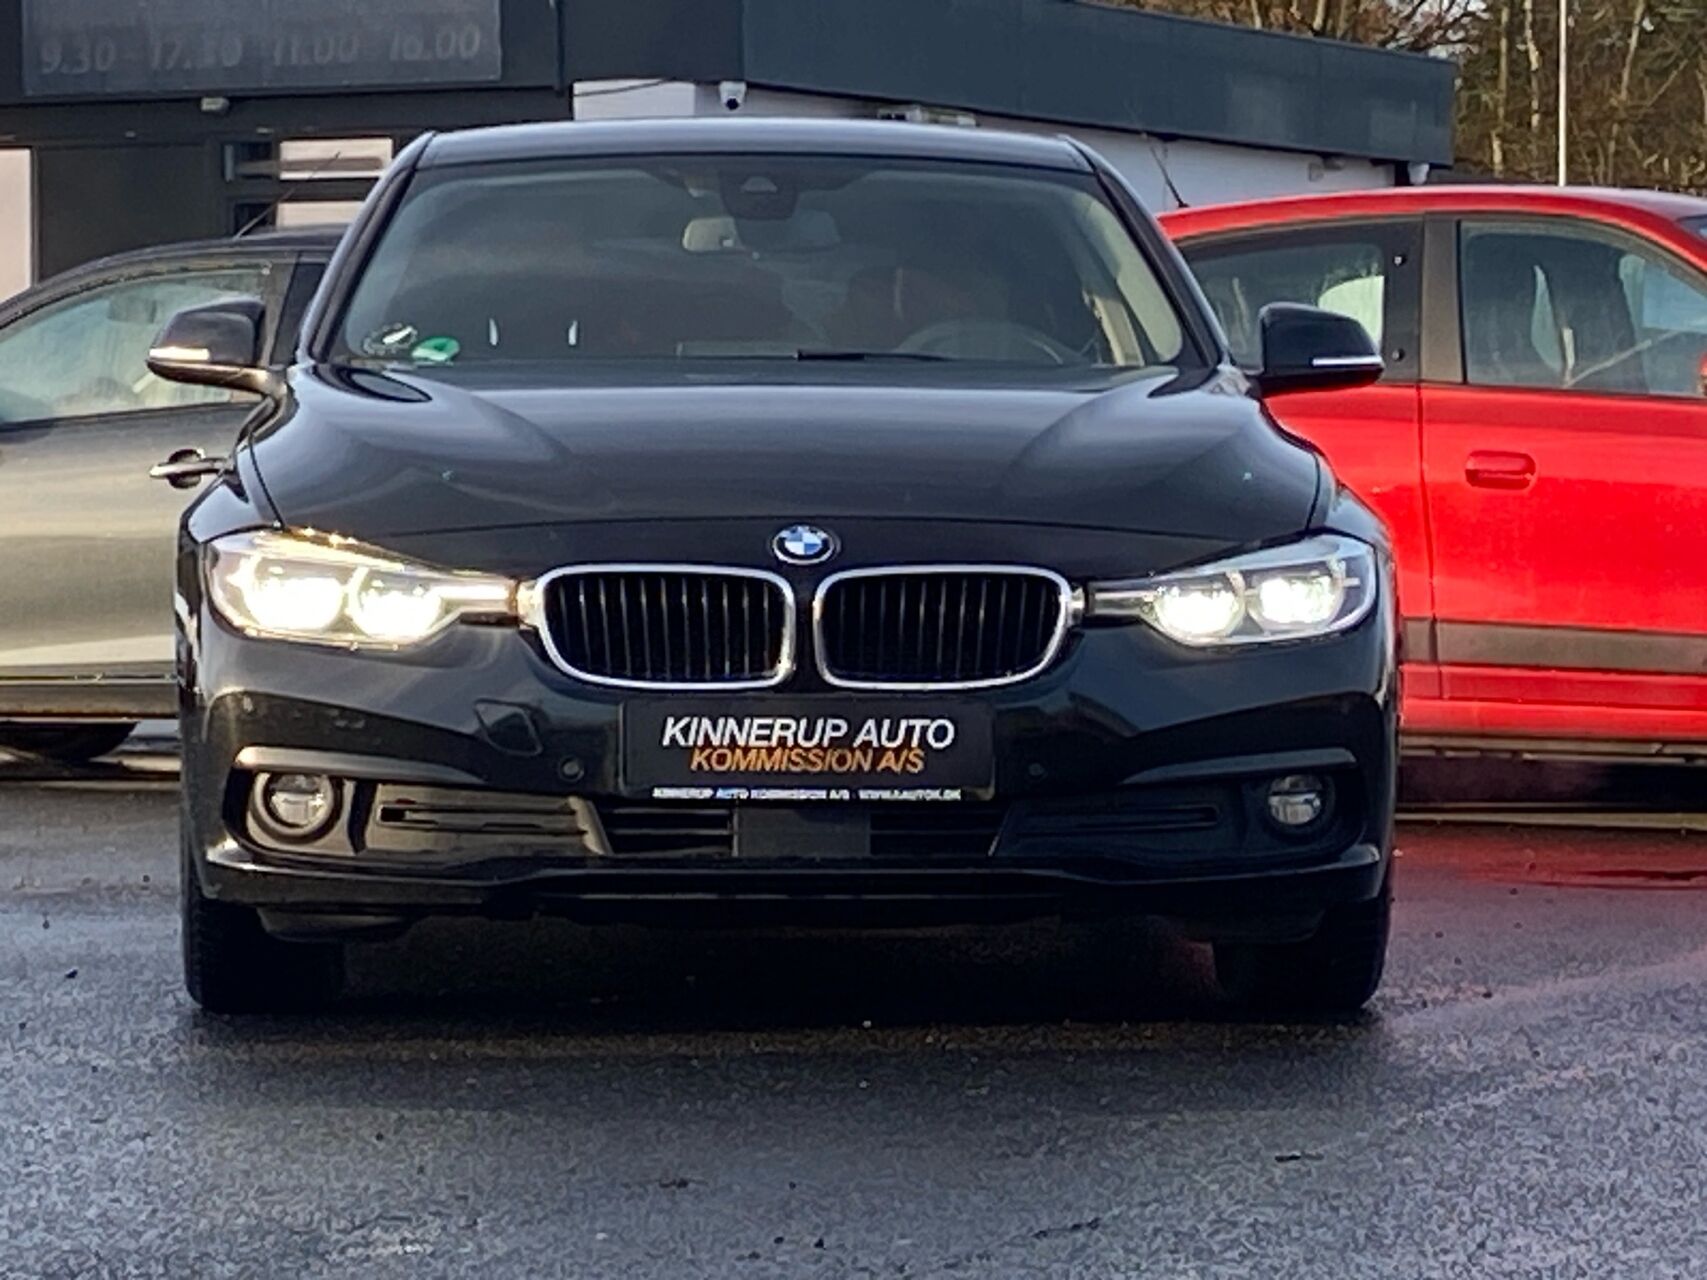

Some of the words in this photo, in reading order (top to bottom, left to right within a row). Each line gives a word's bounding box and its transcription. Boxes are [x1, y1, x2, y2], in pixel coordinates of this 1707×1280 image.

[662, 716, 848, 747] KINNERUP
[853, 718, 954, 749] AUTO
[690, 749, 872, 772] KOMMISSION
[876, 750, 925, 773] A/S
